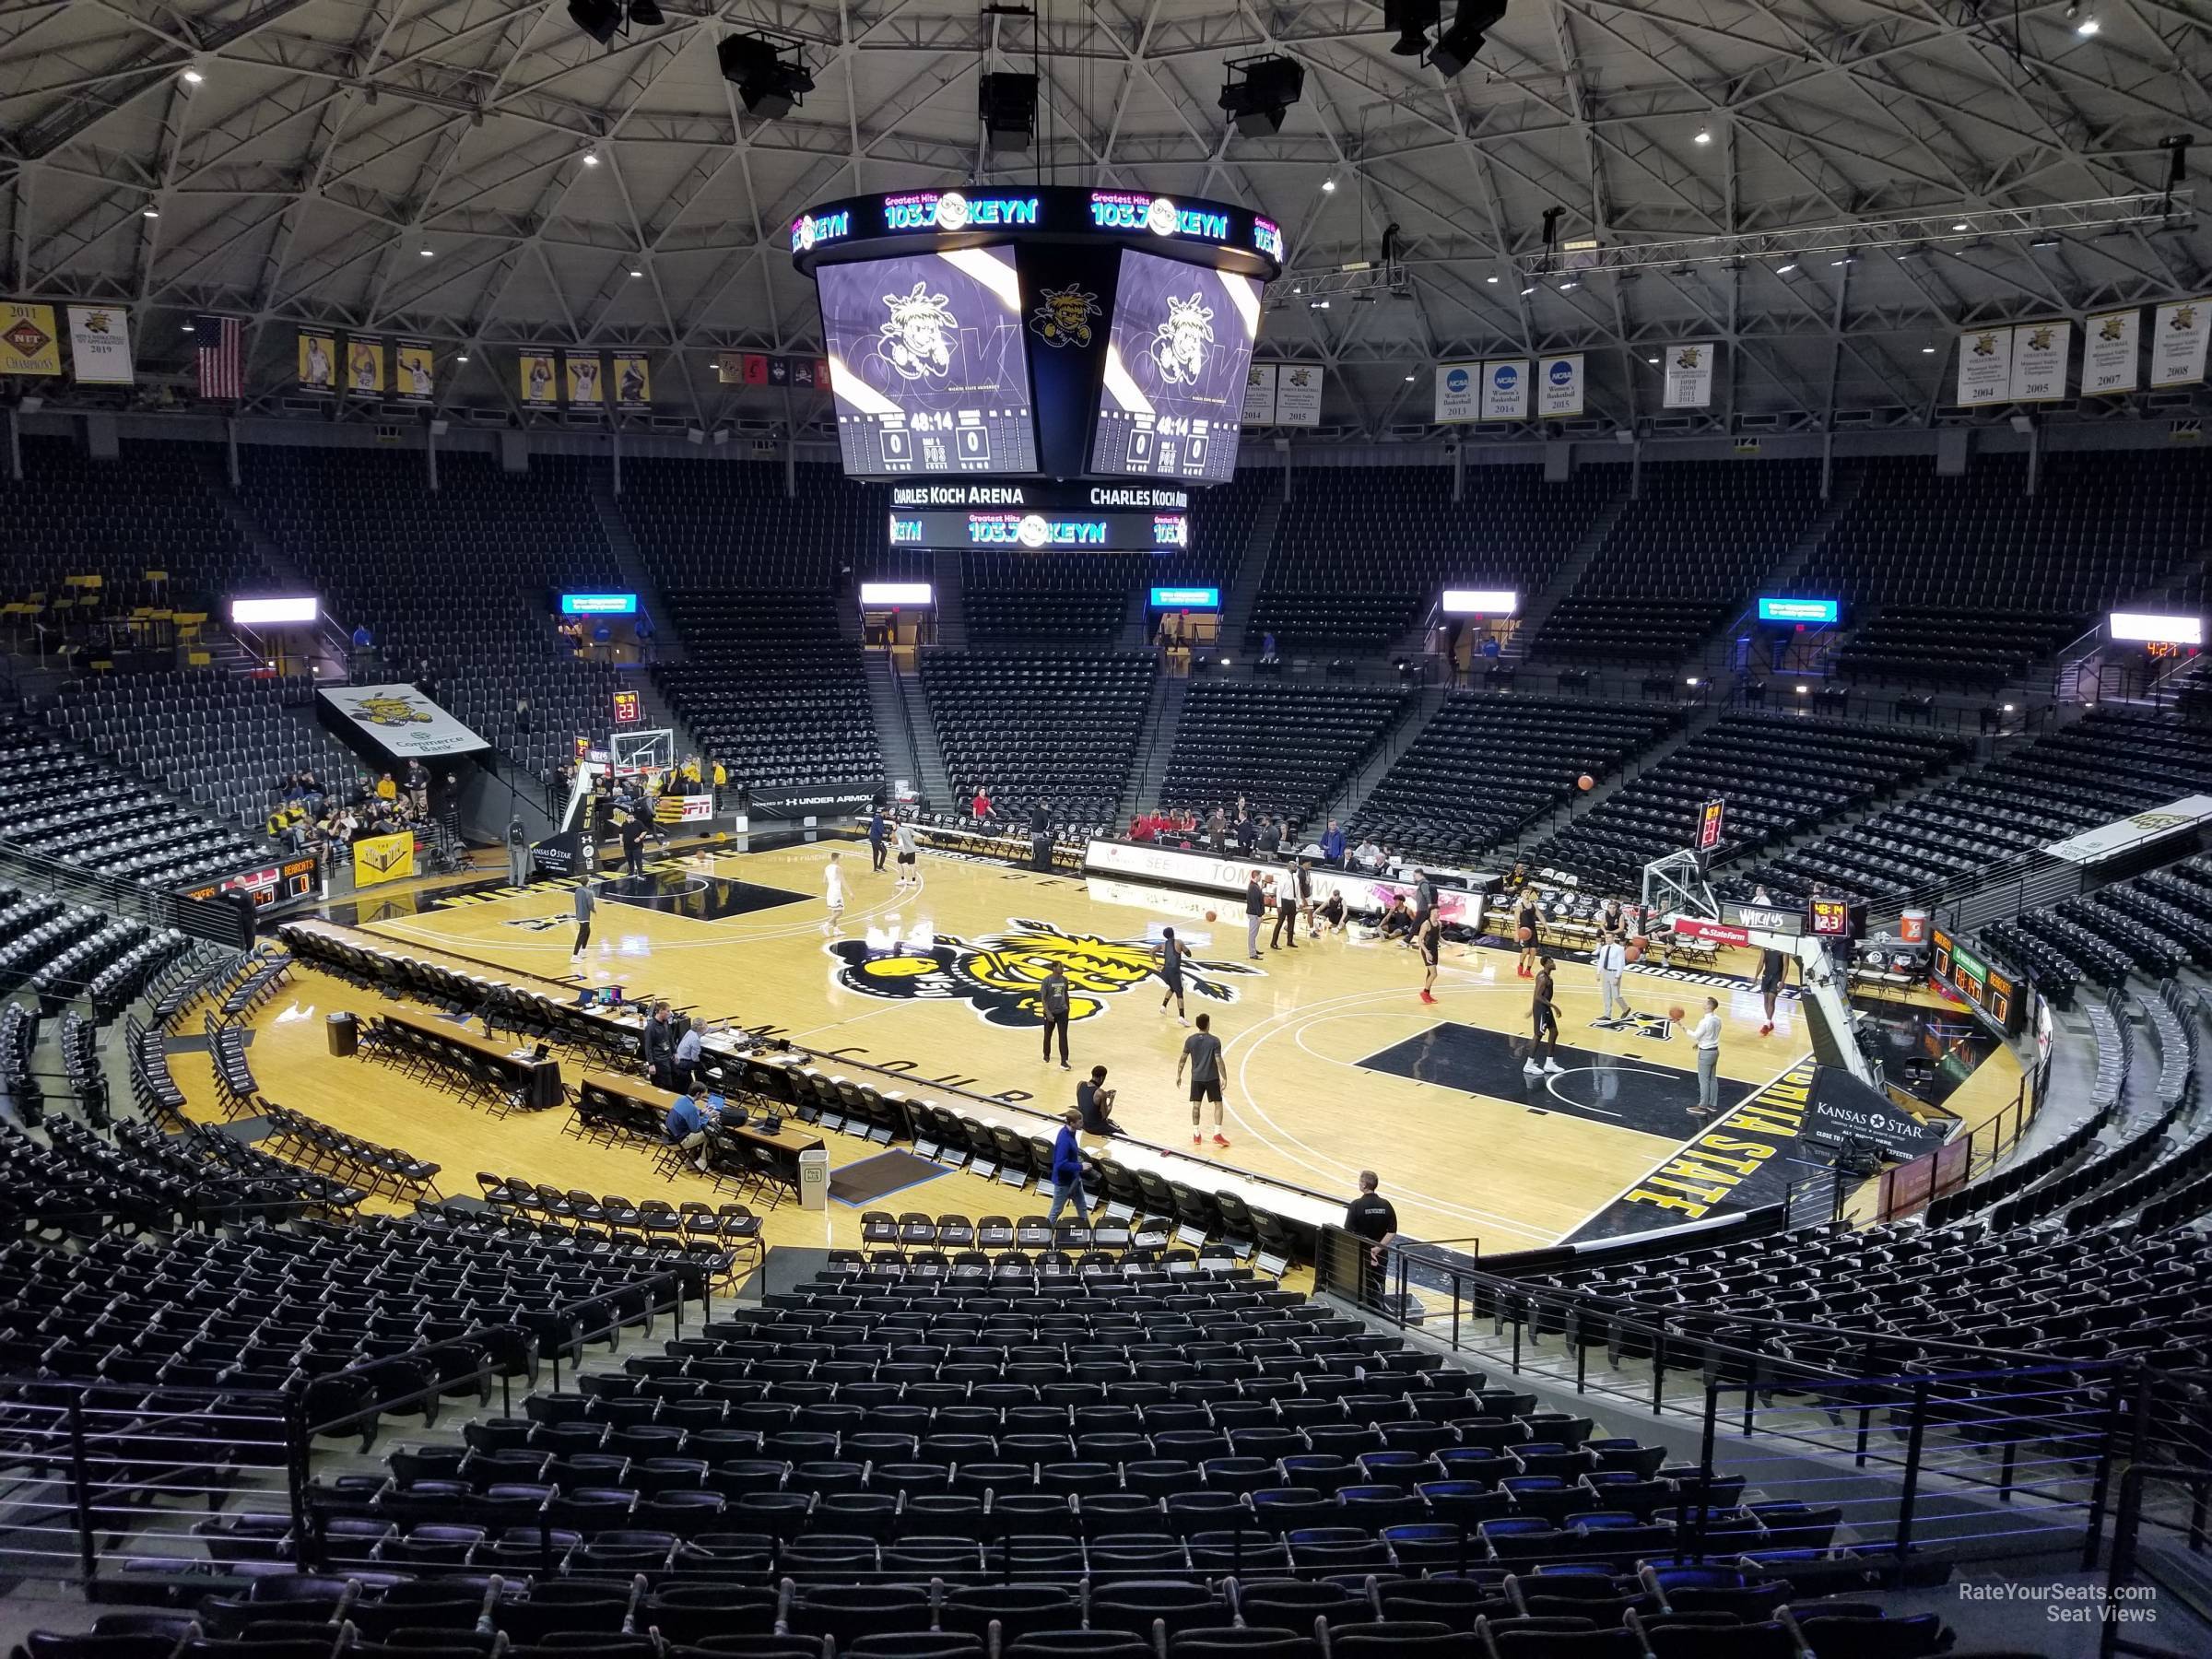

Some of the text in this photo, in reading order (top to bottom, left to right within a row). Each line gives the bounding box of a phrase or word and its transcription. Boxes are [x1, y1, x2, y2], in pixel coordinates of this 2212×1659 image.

[885, 194, 938, 206] Greatest Hits
[1091, 193, 1150, 206] Greatest Hits
[885, 198, 1039, 229] 103.7 KEYN
[1091, 203, 1228, 240] 103.7 KEYN
[10, 306, 37, 319] 2011
[14, 334, 41, 344] NIT
[90, 346, 112, 354] 2019
[2167, 366, 2189, 377] 2008
[1496, 377, 1518, 385] NCAA
[2098, 374, 2121, 385] 2007
[1548, 385, 1575, 394] Women's
[1972, 388, 1994, 398] 2004
[2026, 383, 2049, 394] 2005
[1547, 391, 1576, 400] Basketball
[1494, 406, 1514, 414] 2014
[1551, 401, 1571, 410] 2015
[910, 411, 953, 432] 48:14
[890, 434, 901, 453] 0
[967, 431, 979, 452] 0
[1135, 434, 1146, 454] 0
[1192, 440, 1201, 458] 0
[894, 487, 1024, 504] CHARLES KOCH ARENA
[1090, 488, 1175, 507] CHARLES KOCH
[969, 514, 1020, 523] Greatest Hits
[969, 522, 1107, 544] 103.7 KEYN
[616, 694, 636, 704] 48:14
[619, 703, 635, 719] 23
[396, 736, 465, 748] Commerce
[419, 745, 456, 753] Bank
[798, 796, 834, 806] UNDER
[836, 794, 875, 803] ARMOU
[583, 794, 596, 829] WSU
[557, 852, 571, 860] STAR
[284, 859, 314, 877] BEARCATS
[1147, 858, 1171, 870] SEE
[300, 876, 309, 892] 0
[1815, 904, 1843, 915] 48:14
[1820, 916, 1839, 930] 23
[1941, 955, 1947, 974] 0
[1956, 968, 1975, 996] 48:14
[1990, 972, 2012, 997] BEARCATS
[1999, 1001, 2006, 1021] 0
[1817, 1101, 1924, 1139] KANSAS STAR
[1816, 1131, 1831, 1141] CLOSE
[1623, 1133, 1778, 1219] STATE
